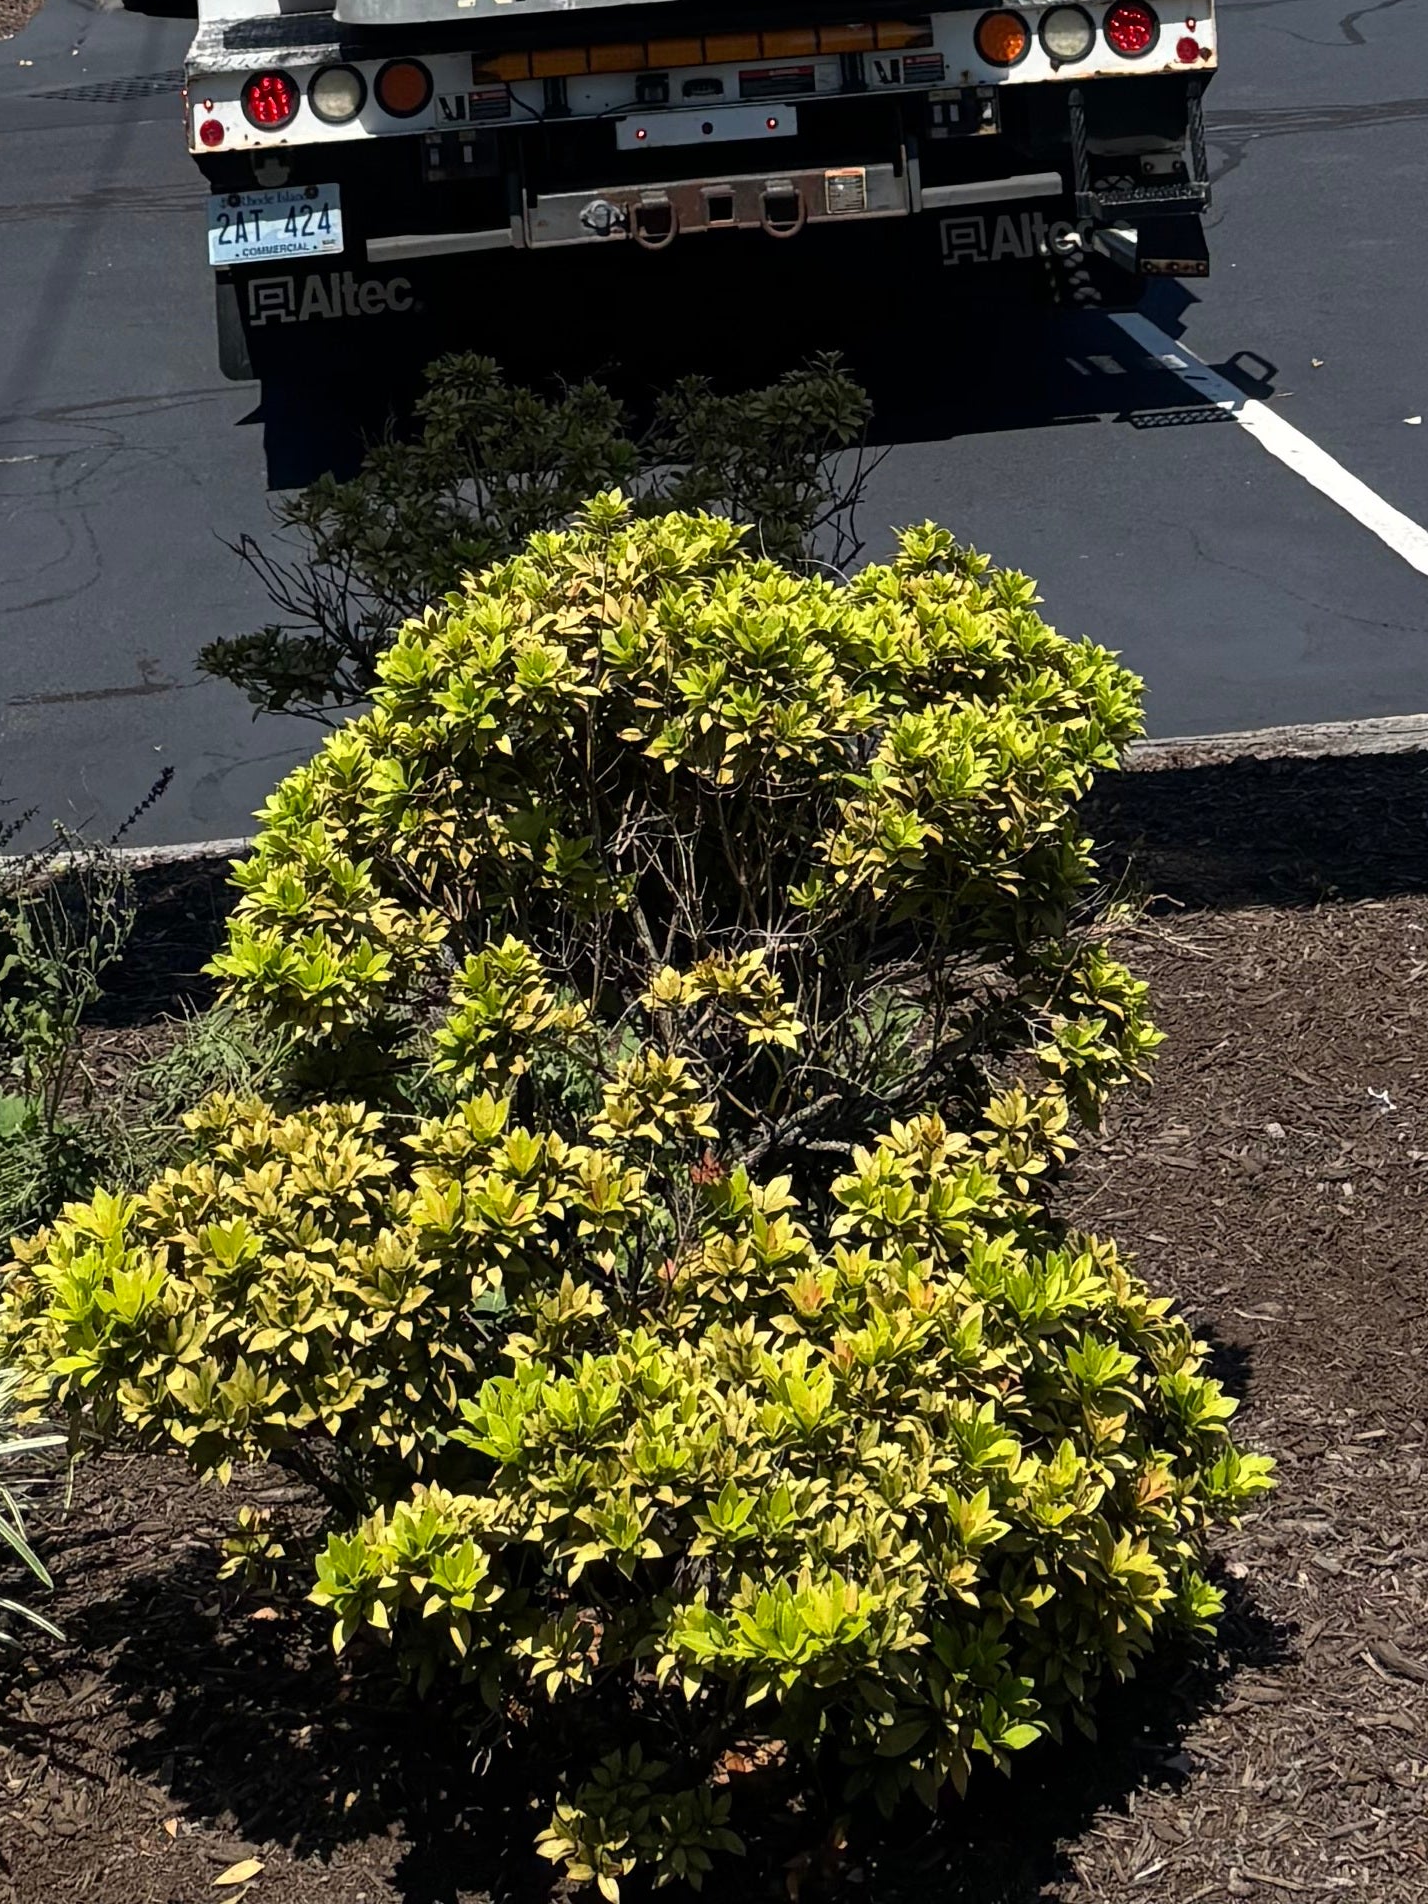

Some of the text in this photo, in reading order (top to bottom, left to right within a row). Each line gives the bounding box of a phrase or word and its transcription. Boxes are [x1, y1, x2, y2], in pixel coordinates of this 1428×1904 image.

[216, 202, 332, 245] 2AT 424
[242, 243, 310, 257] COMMERCIAL
[299, 271, 414, 321] Altec
